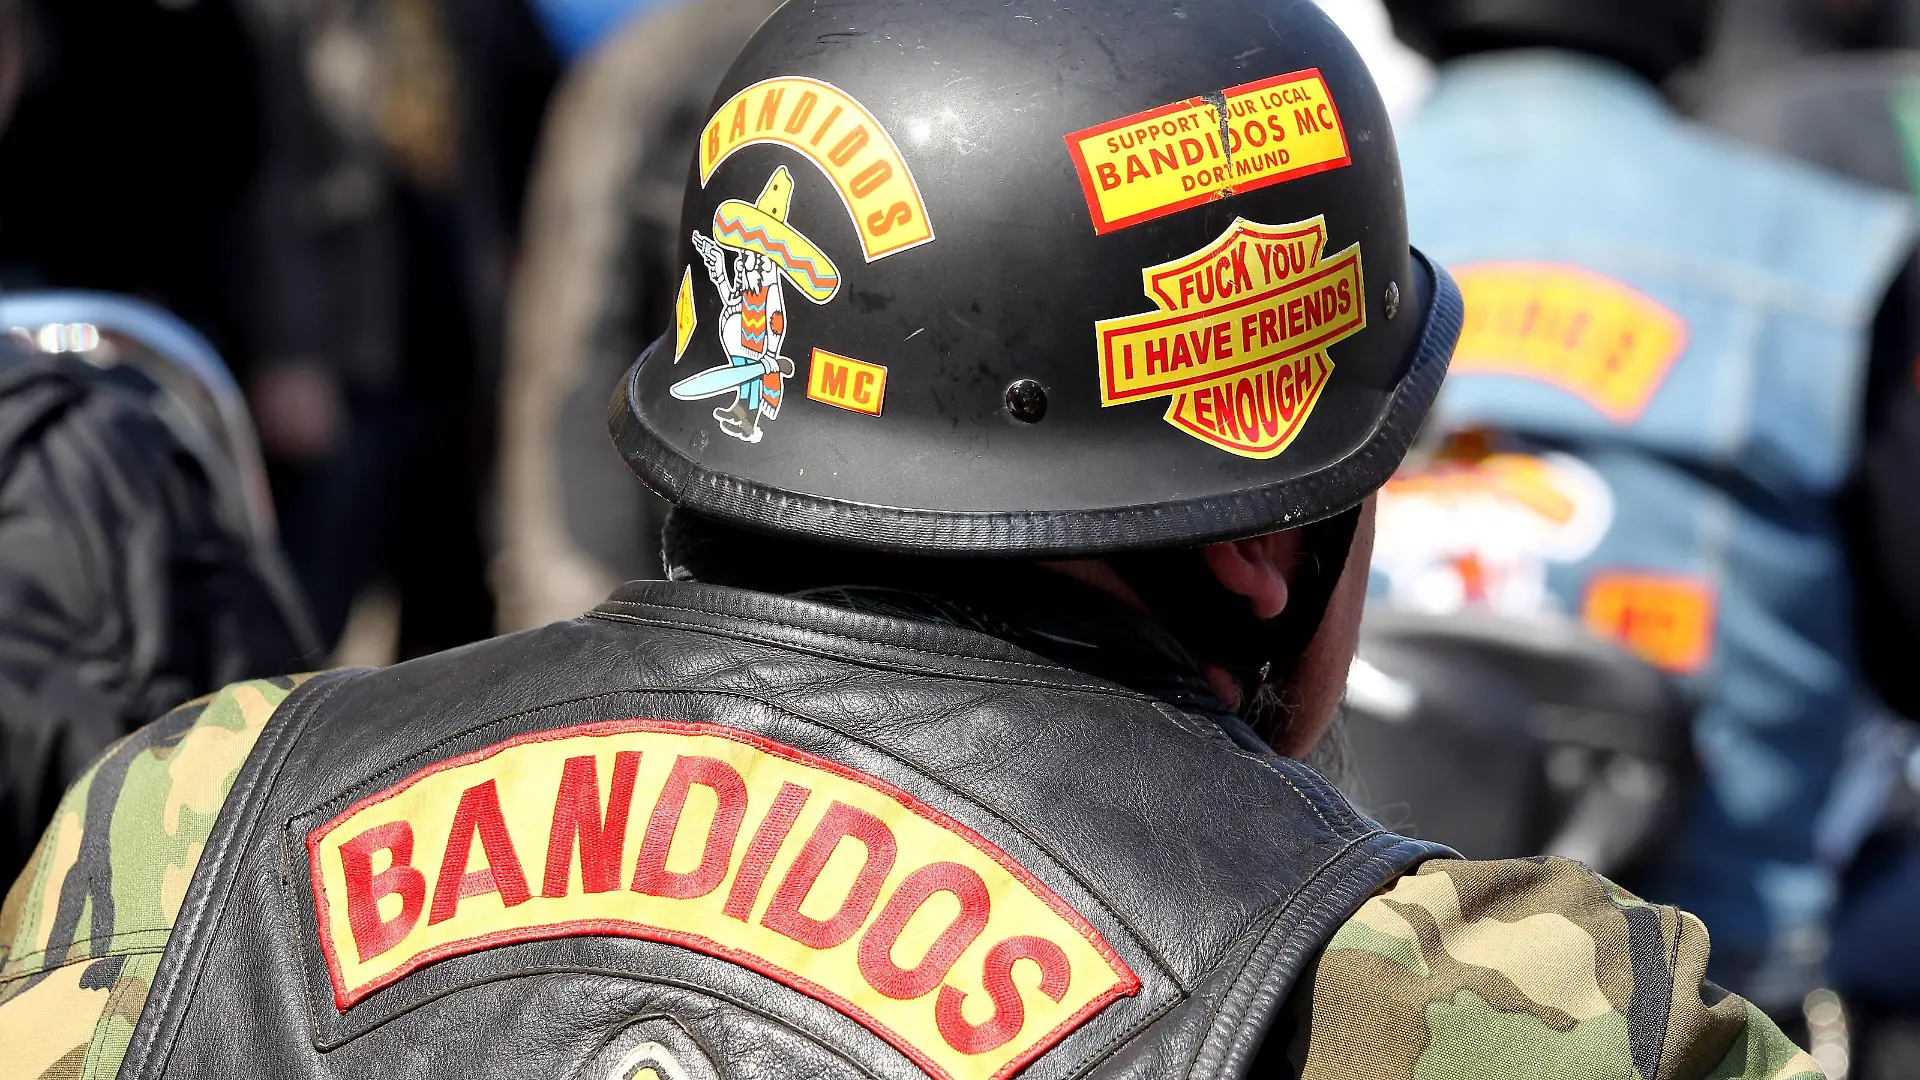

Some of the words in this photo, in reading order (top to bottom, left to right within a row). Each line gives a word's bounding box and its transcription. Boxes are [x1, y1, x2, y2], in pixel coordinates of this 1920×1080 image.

[708, 87, 913, 237] BANDIDOS
[1096, 115, 1286, 192] BANDIDOS
[1294, 103, 1334, 136] MC
[1106, 113, 1200, 154] SUPPORT
[1261, 86, 1312, 109] LOCAL
[1181, 148, 1290, 192] DORTMUND
[1179, 241, 1253, 308] FUCK
[1255, 241, 1305, 284] YOU
[1123, 344, 1133, 379] I
[1144, 321, 1232, 376] HAVE
[1241, 277, 1352, 353] FRIENDS
[819, 361, 875, 406] MC
[1193, 356, 1312, 443] ENOUGH
[338, 750, 1071, 1055] BANDIDOS
